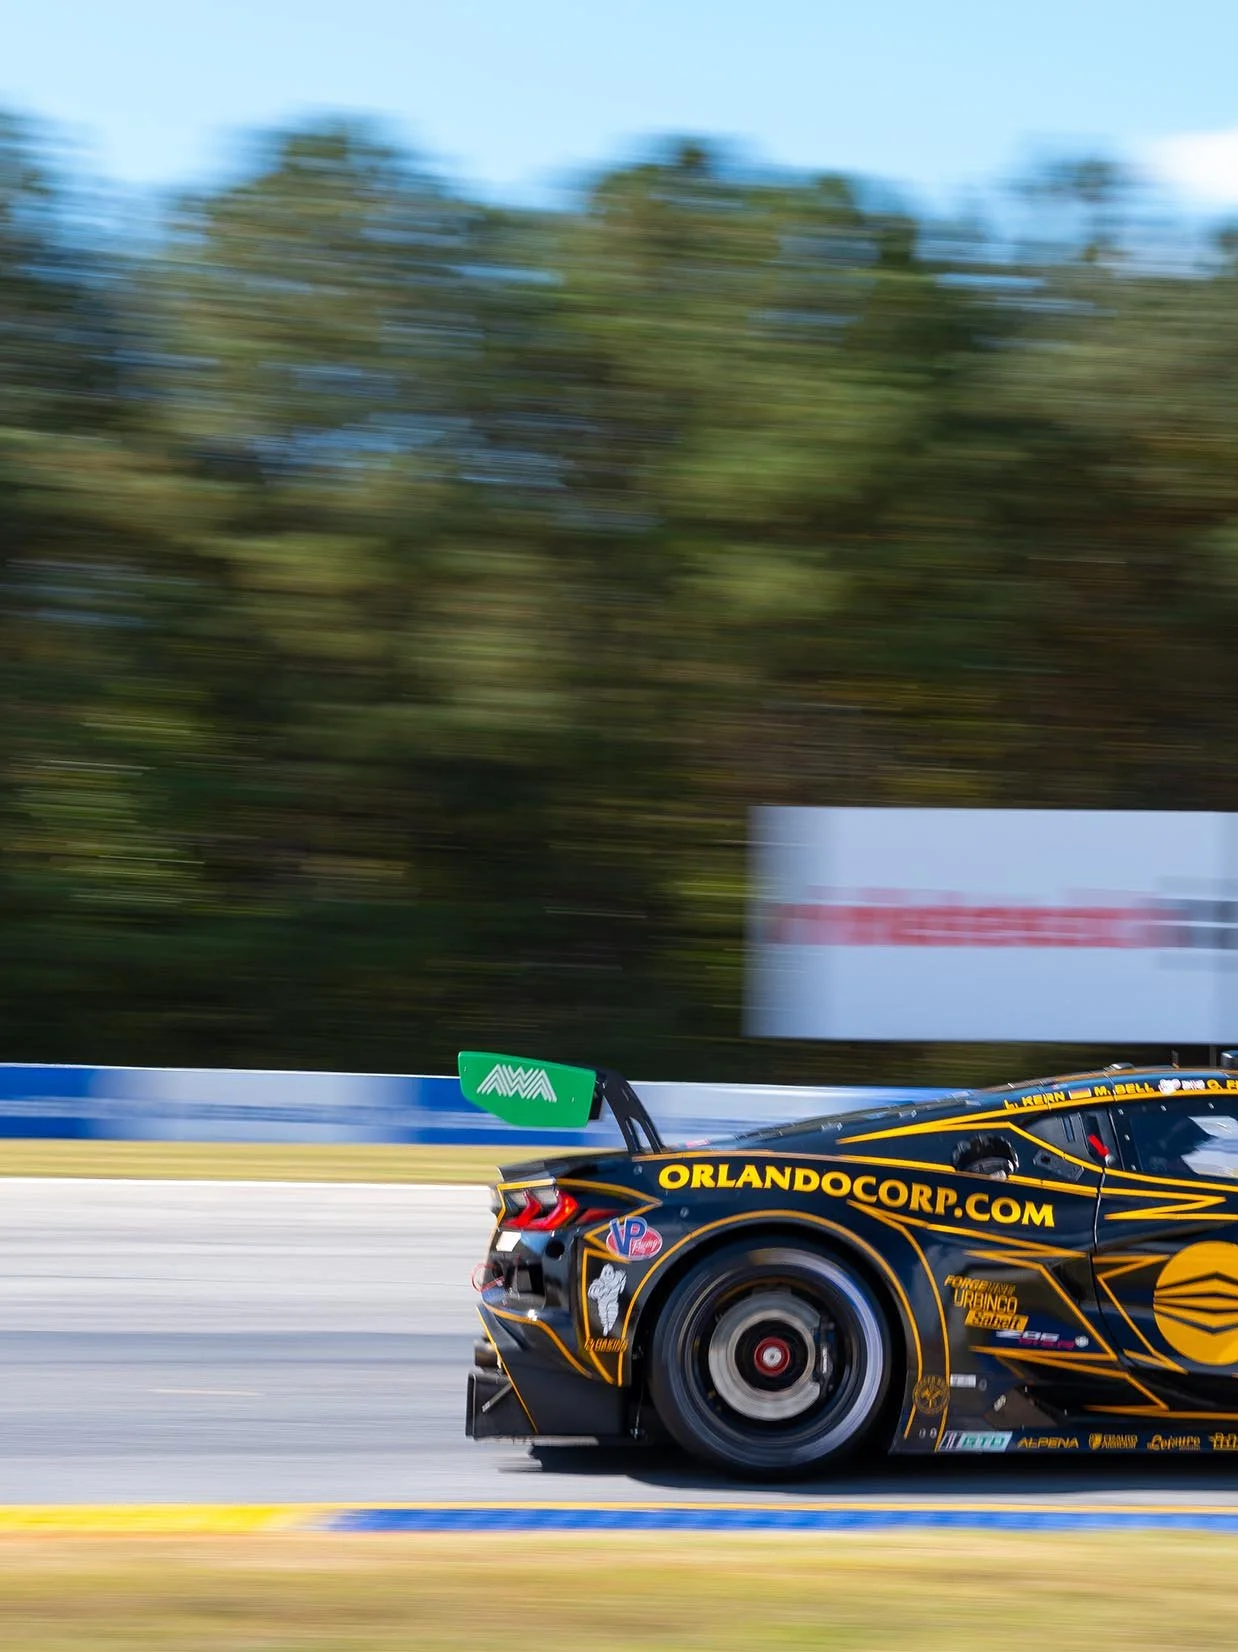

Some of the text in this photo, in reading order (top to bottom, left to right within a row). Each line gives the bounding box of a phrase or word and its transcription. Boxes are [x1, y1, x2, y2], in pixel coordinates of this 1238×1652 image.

[476, 1064, 557, 1103] AWA
[1021, 1091, 1065, 1106] KERN
[1114, 1082, 1155, 1095] BELL
[658, 1163, 1056, 1228] ORLANDOCORP.COM
[609, 1217, 647, 1257] VP
